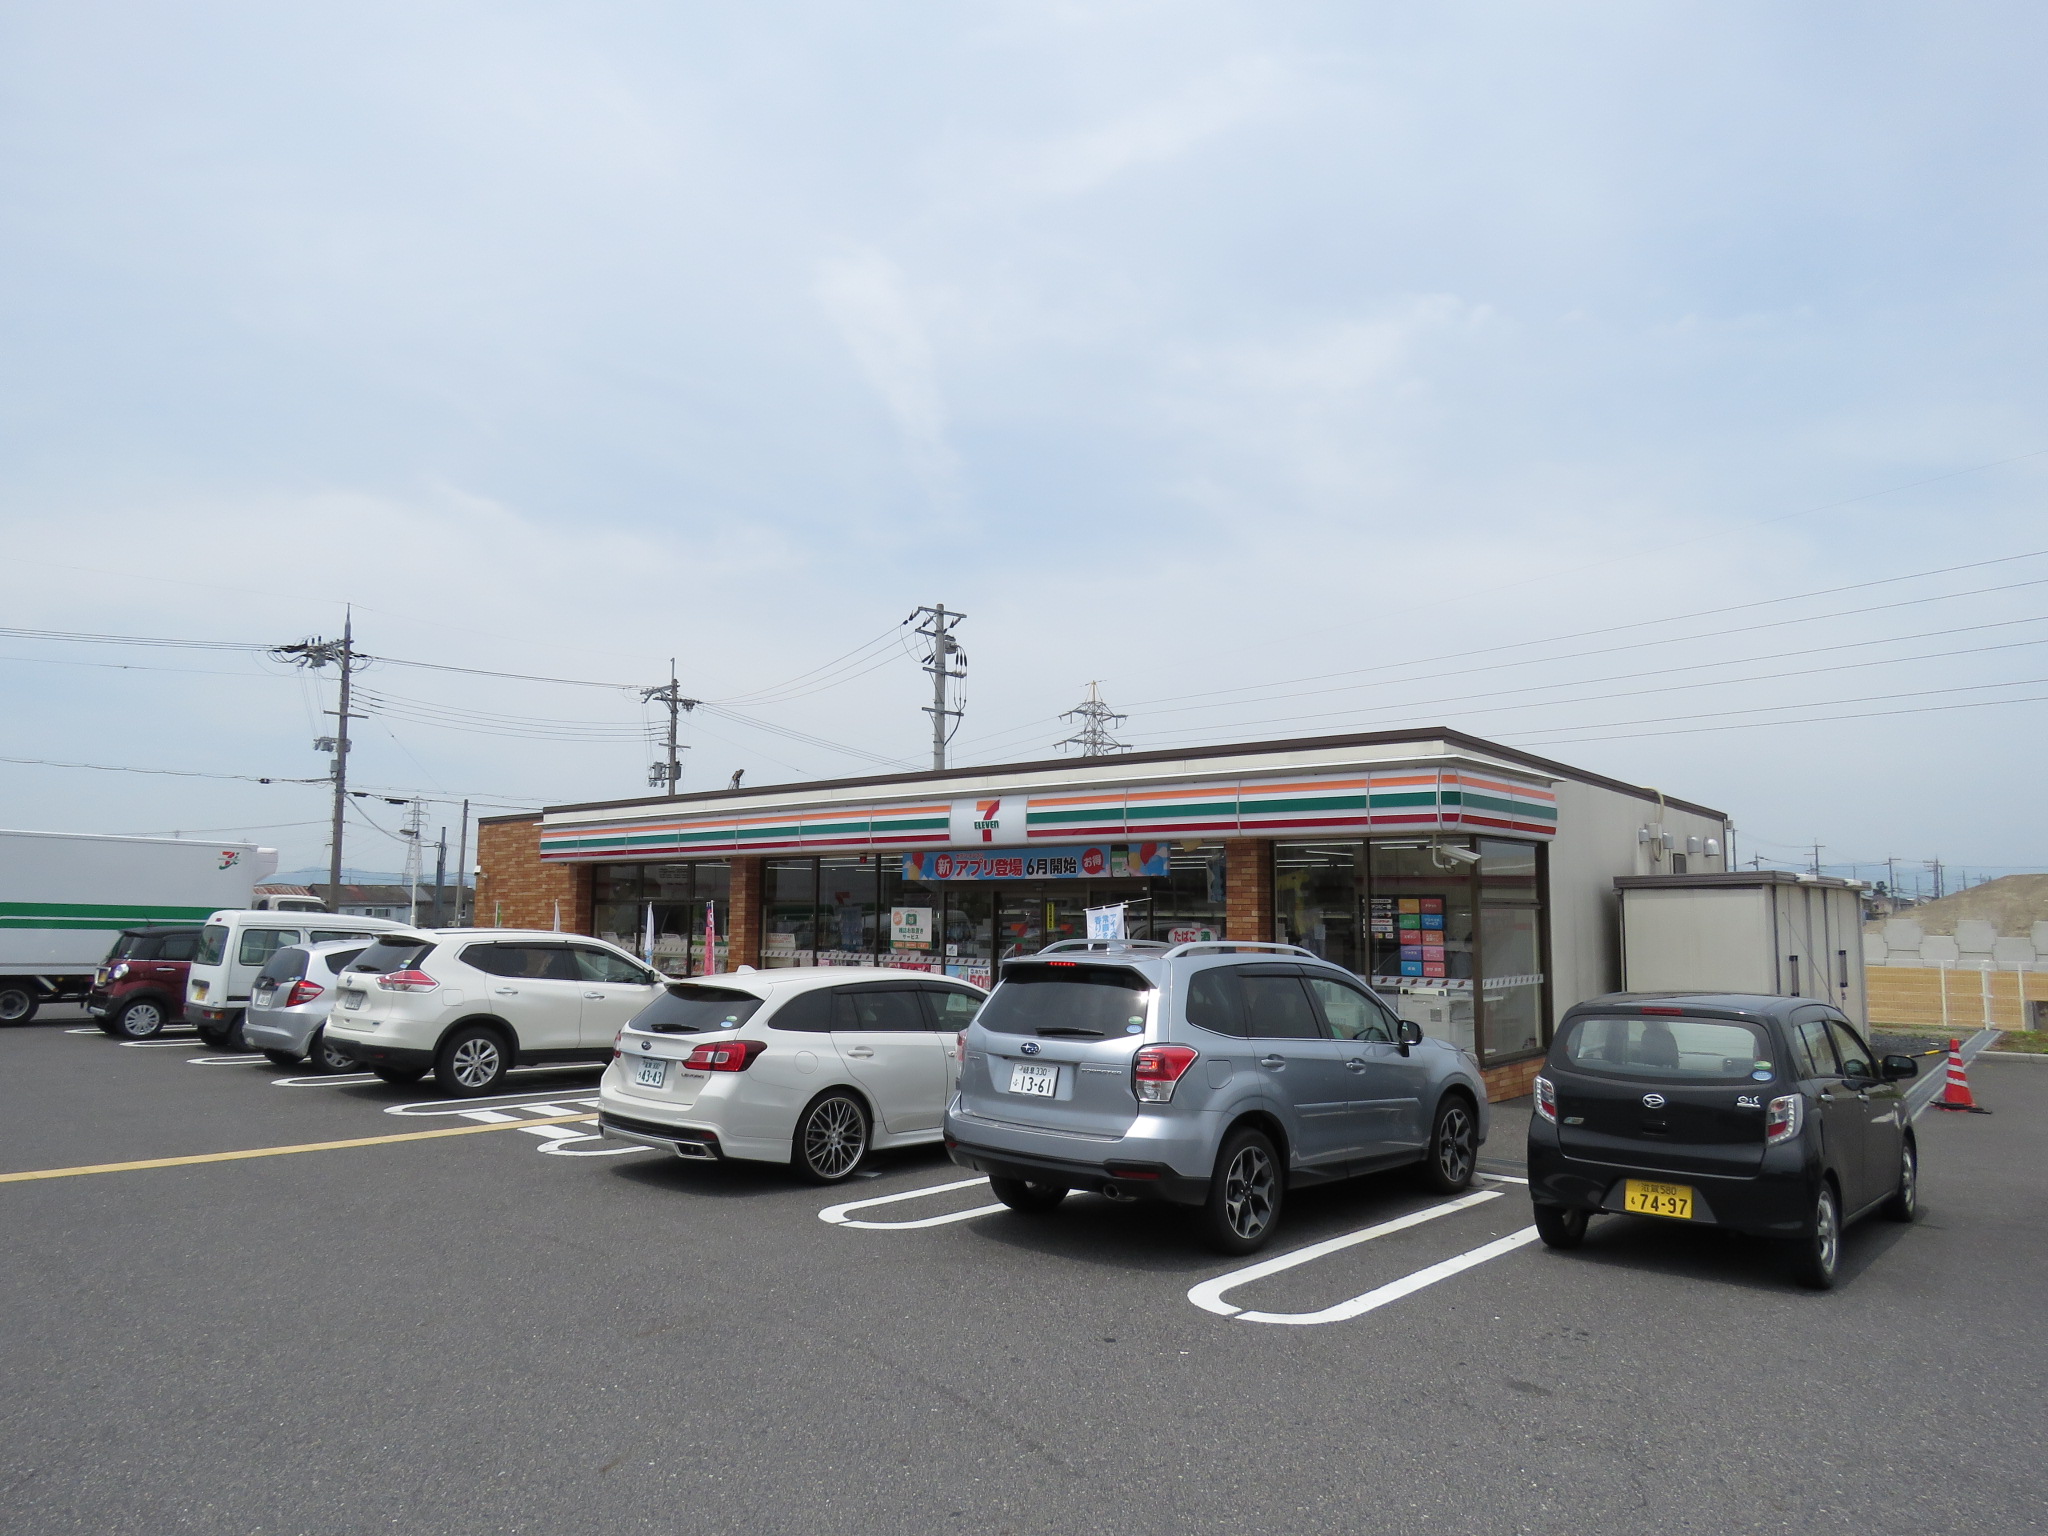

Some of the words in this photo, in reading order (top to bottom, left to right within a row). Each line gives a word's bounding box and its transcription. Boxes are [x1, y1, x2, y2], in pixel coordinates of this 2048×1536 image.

[938, 858, 951, 875] 新
[956, 858, 1023, 877] アプリ登場
[1026, 857, 1077, 876] 6月開始
[1083, 854, 1102, 868] お得
[1173, 930, 1197, 943] たばこ
[641, 1069, 662, 1084] 43-43
[1035, 1067, 1047, 1077] 330
[1020, 1076, 1051, 1094] 13-61
[1660, 1185, 1677, 1195] 580
[1639, 1193, 1688, 1215] 74-97
